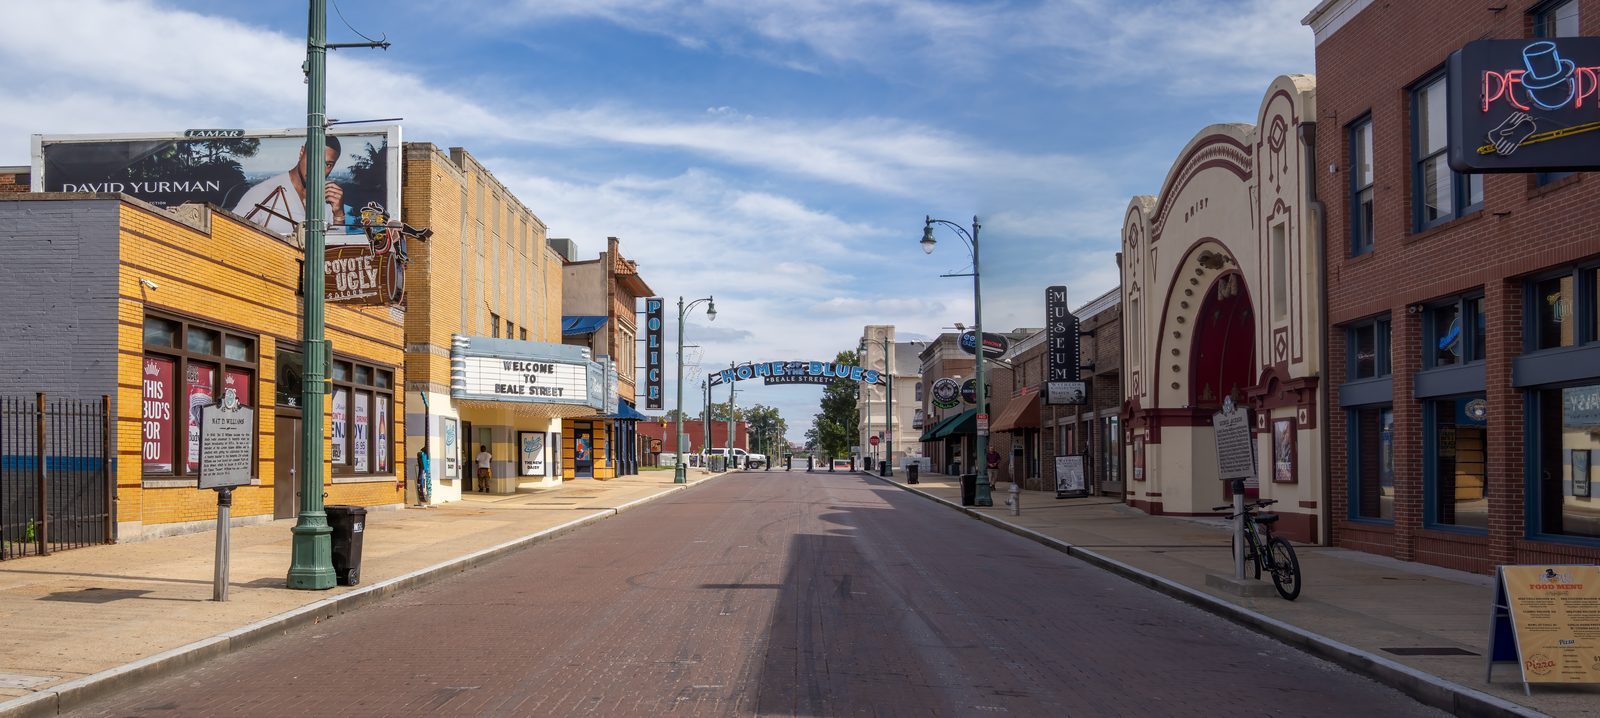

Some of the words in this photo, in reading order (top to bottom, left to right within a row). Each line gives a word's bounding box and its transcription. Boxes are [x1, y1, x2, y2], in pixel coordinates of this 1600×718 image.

[63, 182, 124, 193] DAVID
[130, 180, 220, 193] YURMAN
[325, 256, 375, 274] COYOTE
[336, 269, 378, 291] UGLY
[1054, 291, 1067, 379] MUSEUM
[648, 300, 661, 400] POLICE
[503, 361, 554, 373] WELCOME
[719, 361, 784, 383] HOME
[808, 361, 880, 384] BLUES
[523, 373, 536, 384] TO
[144, 380, 163, 399] THIS
[494, 383, 525, 395] BEALE
[529, 385, 564, 397] STREET
[1526, 660, 1556, 670] Pizza
